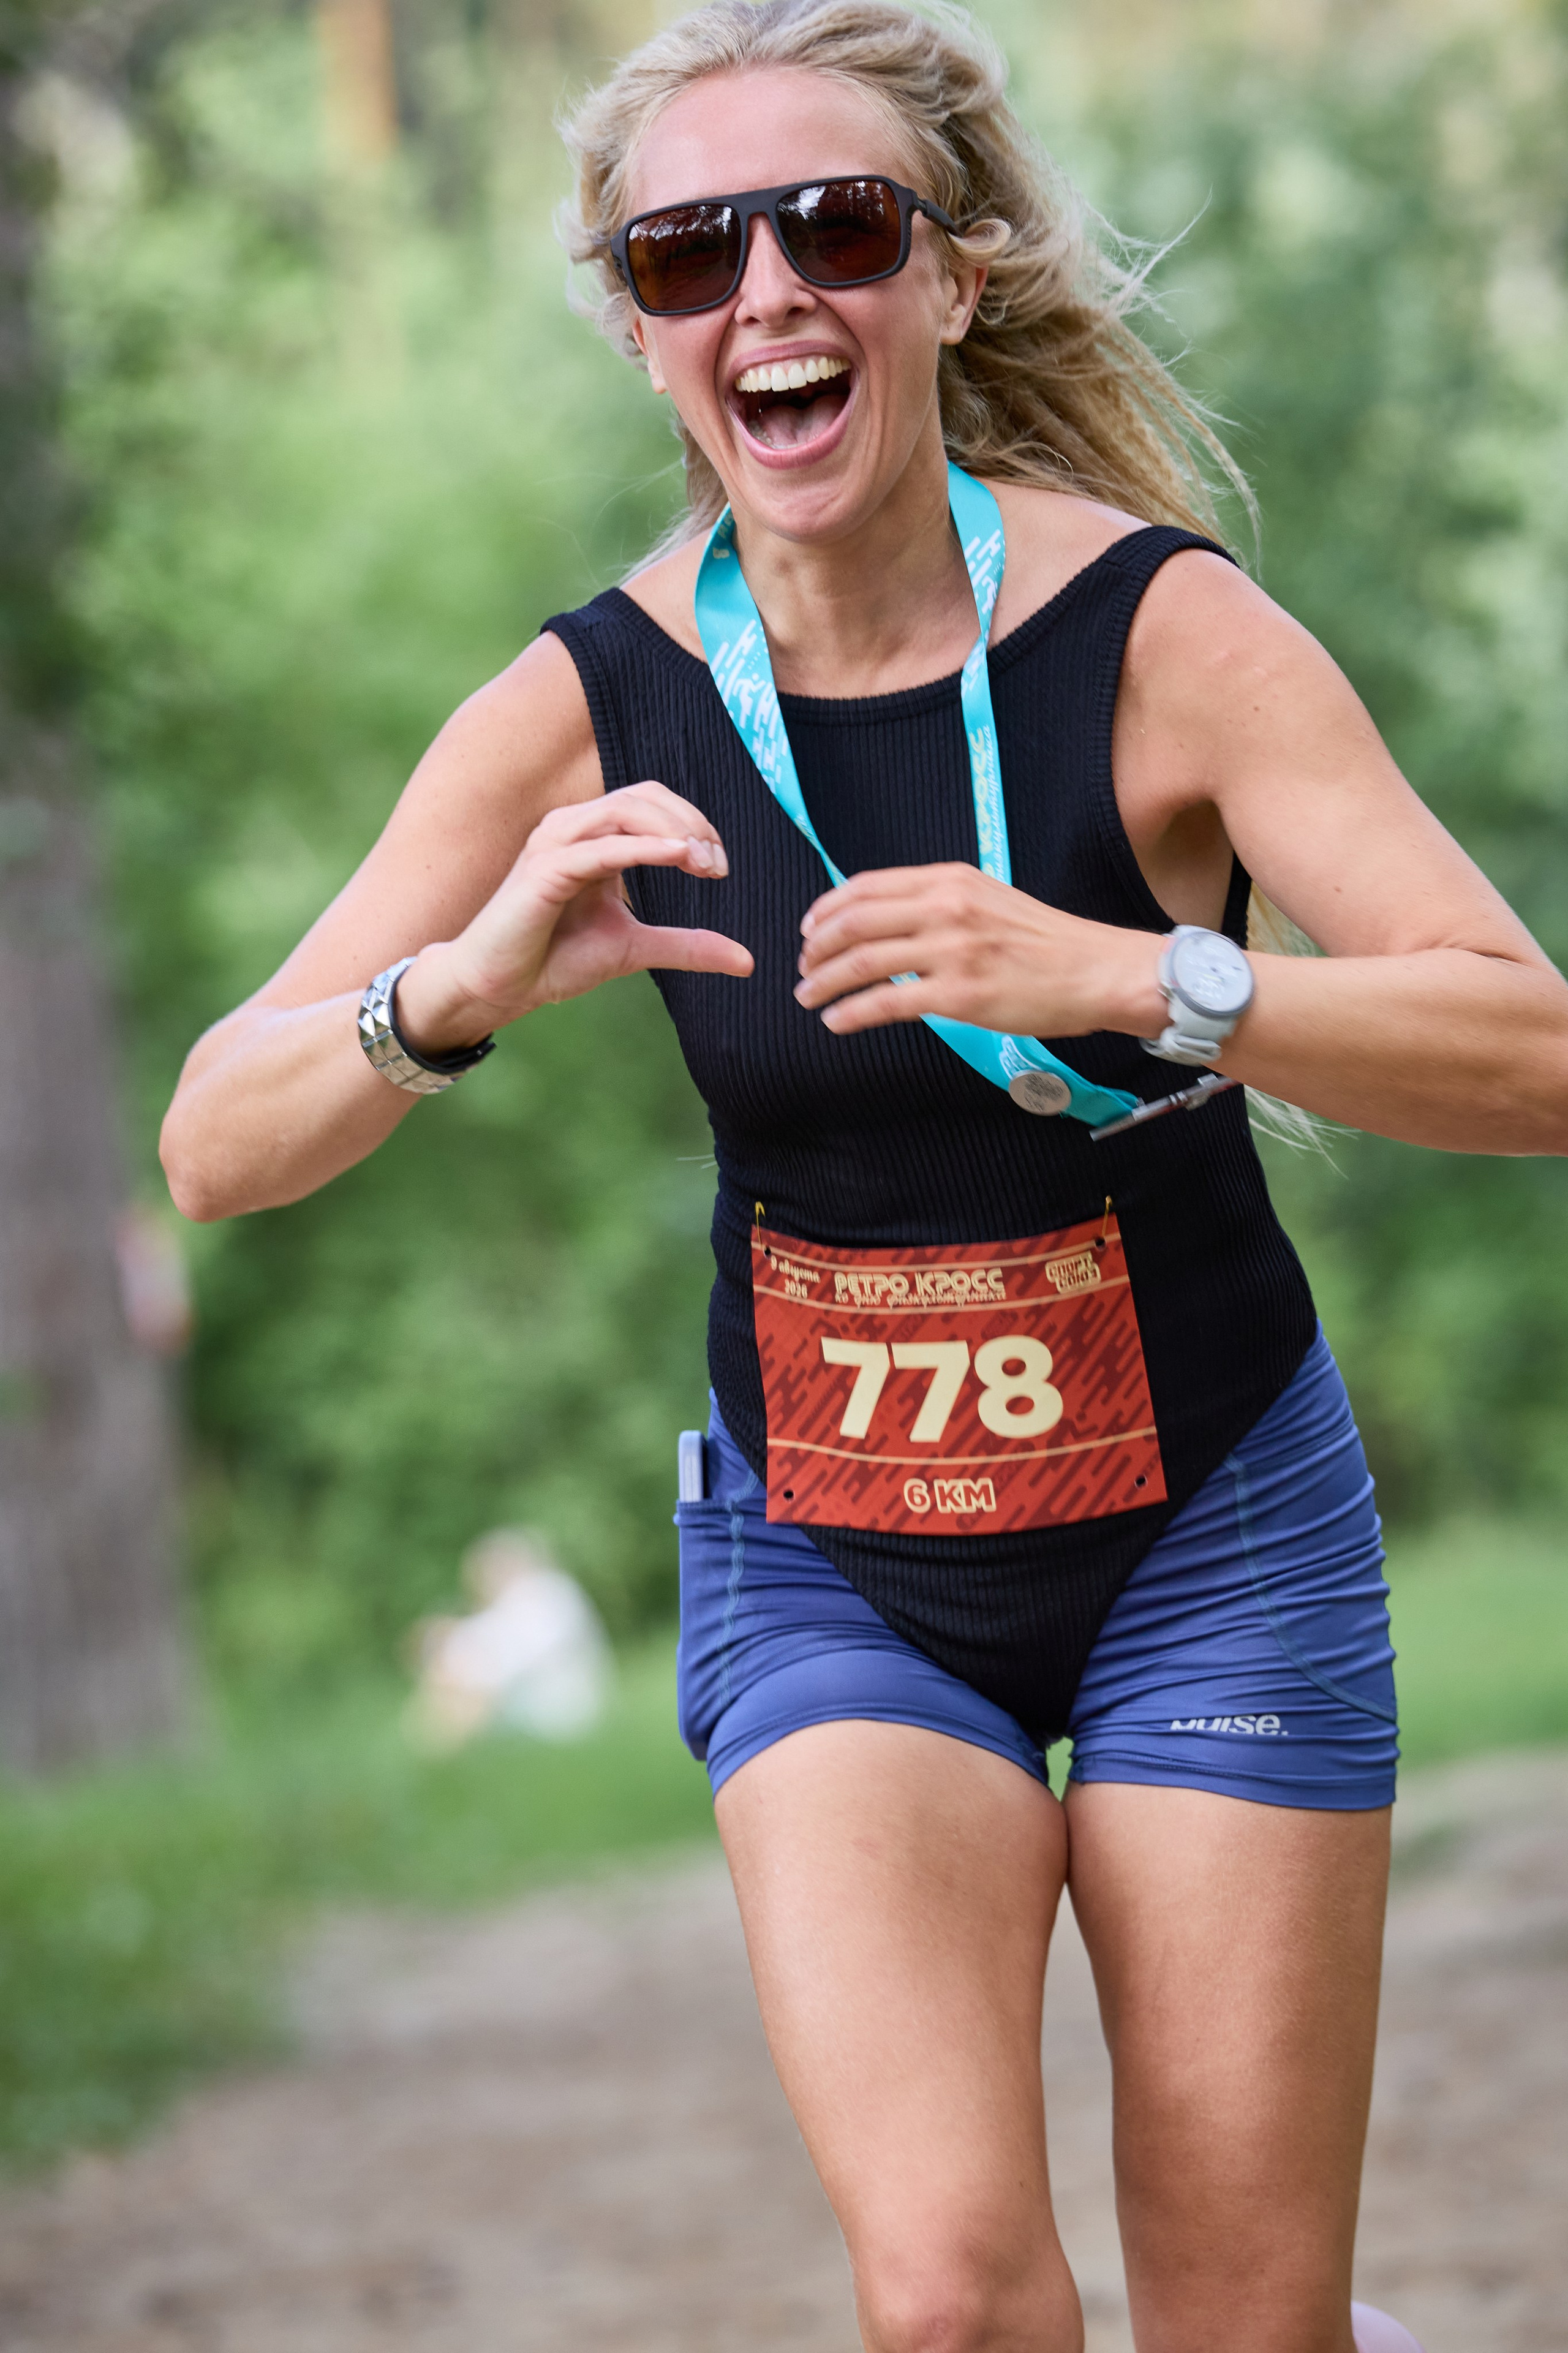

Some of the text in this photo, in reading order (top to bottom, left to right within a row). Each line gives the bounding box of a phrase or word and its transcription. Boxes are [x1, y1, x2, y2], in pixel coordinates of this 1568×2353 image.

[834, 1267, 1004, 1297] РЕТРО КРОСС
[821, 1335, 1063, 1443] 778
[903, 1477, 997, 1514] 6 КМ
